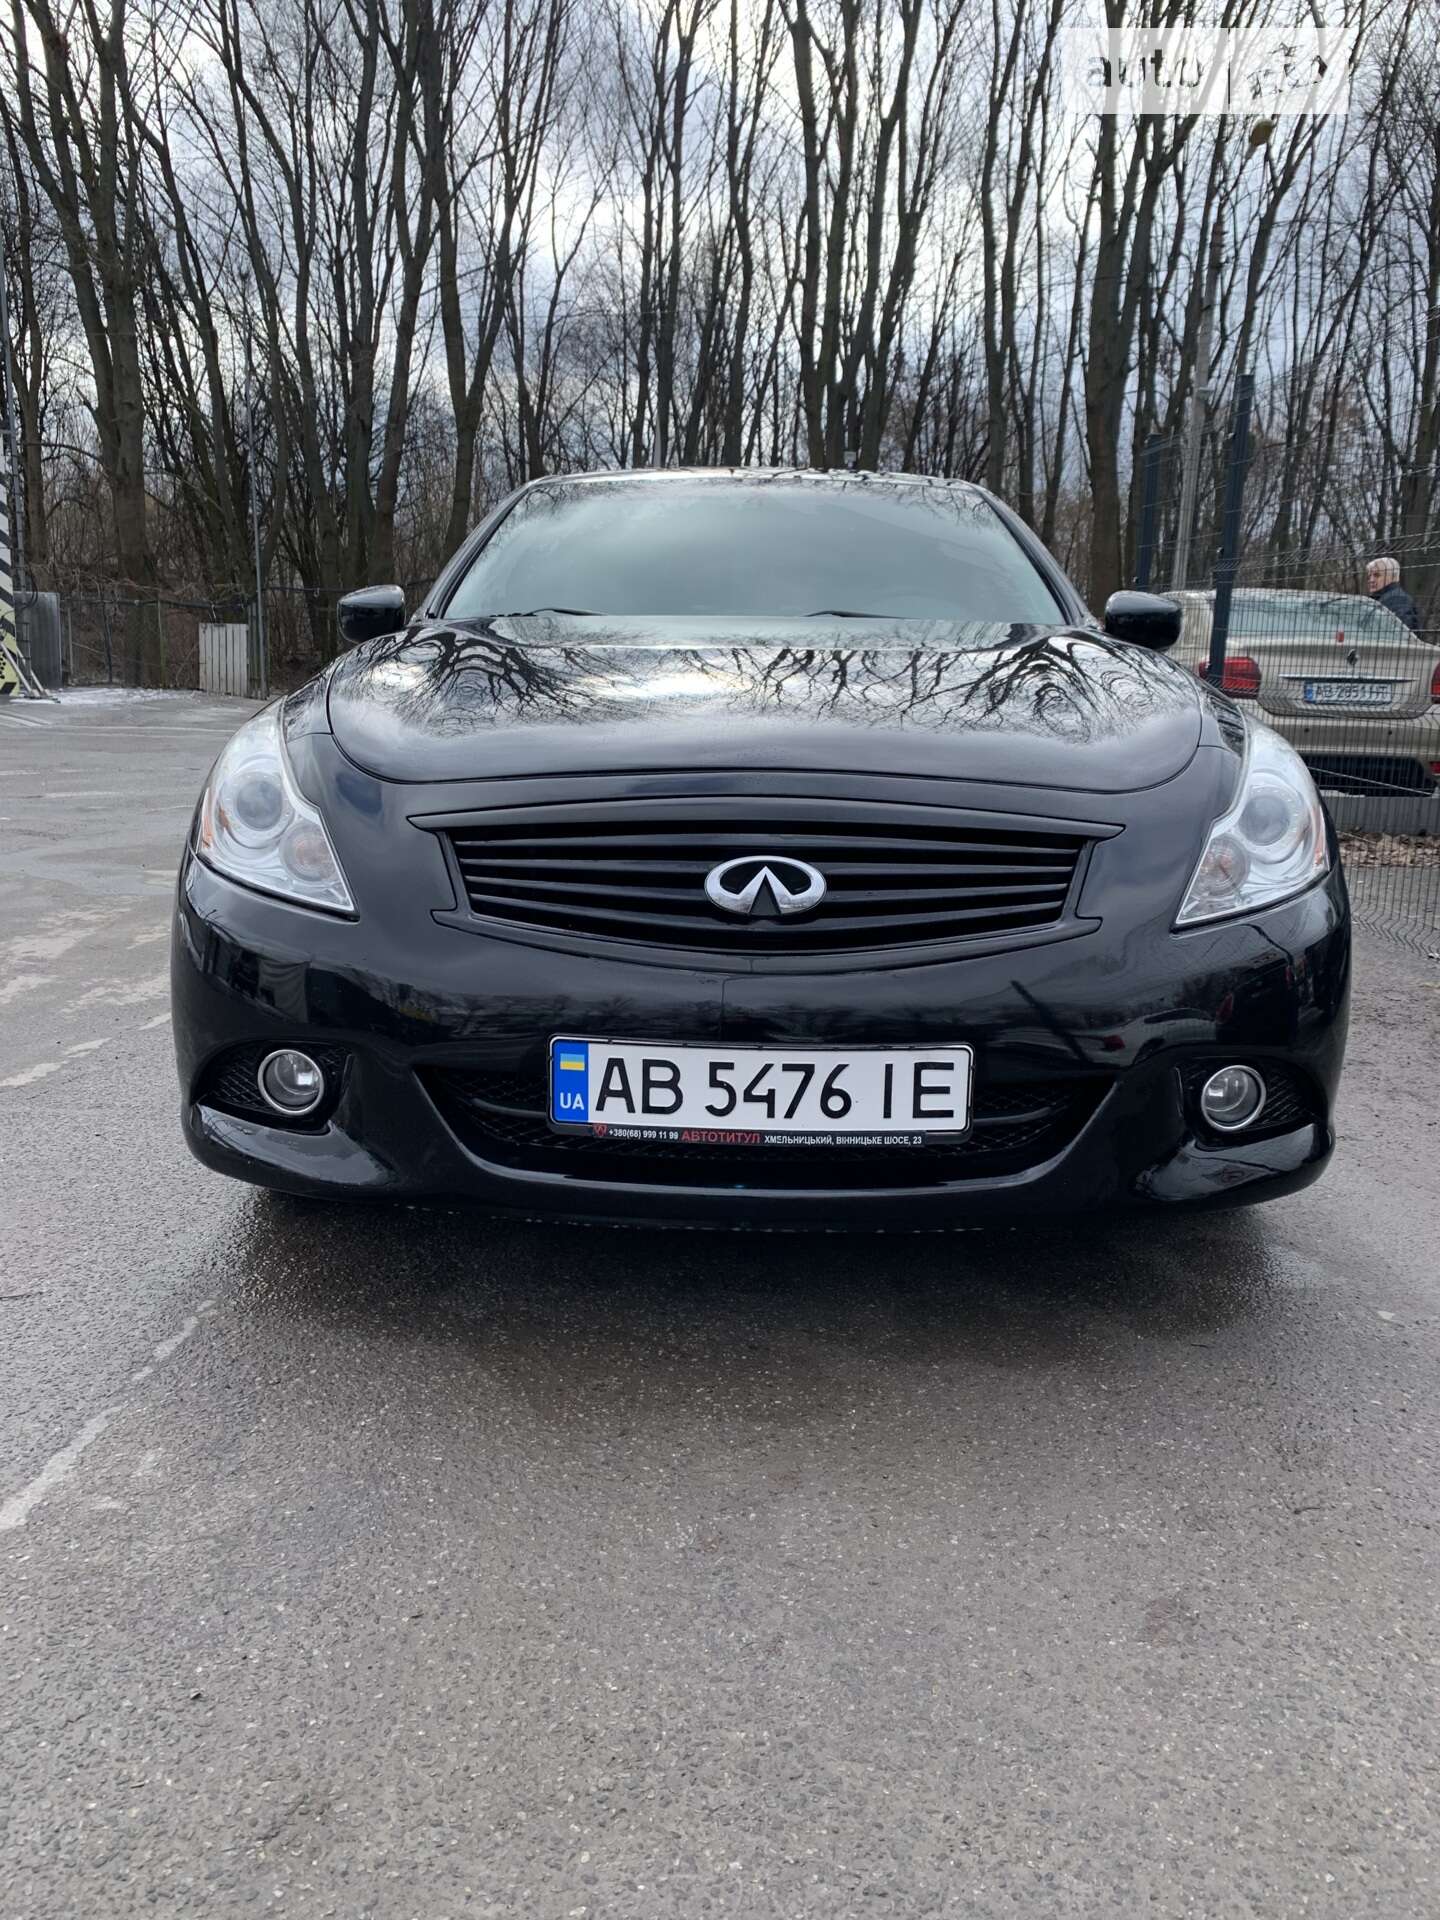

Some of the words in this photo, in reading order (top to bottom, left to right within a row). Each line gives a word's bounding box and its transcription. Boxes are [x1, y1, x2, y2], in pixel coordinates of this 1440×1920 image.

[595, 1056, 684, 1115] AB
[704, 1061, 852, 1119] 5476
[882, 1061, 955, 1119] IE
[559, 1092, 585, 1111] UA
[608, 1128, 642, 1139] +380(68)
[643, 1130, 657, 1139] 999
[658, 1131, 667, 1140] 11
[669, 1131, 679, 1140] 99
[681, 1129, 761, 1144] АВТОТИТУЛ
[764, 1134, 835, 1146] ХМЕЛЬНИЦЬКИЙ,
[836, 1135, 883, 1146] ВІННИЦЬКЕ
[884, 1135, 911, 1146] ШОСЕ,
[912, 1135, 922, 1145] 23
